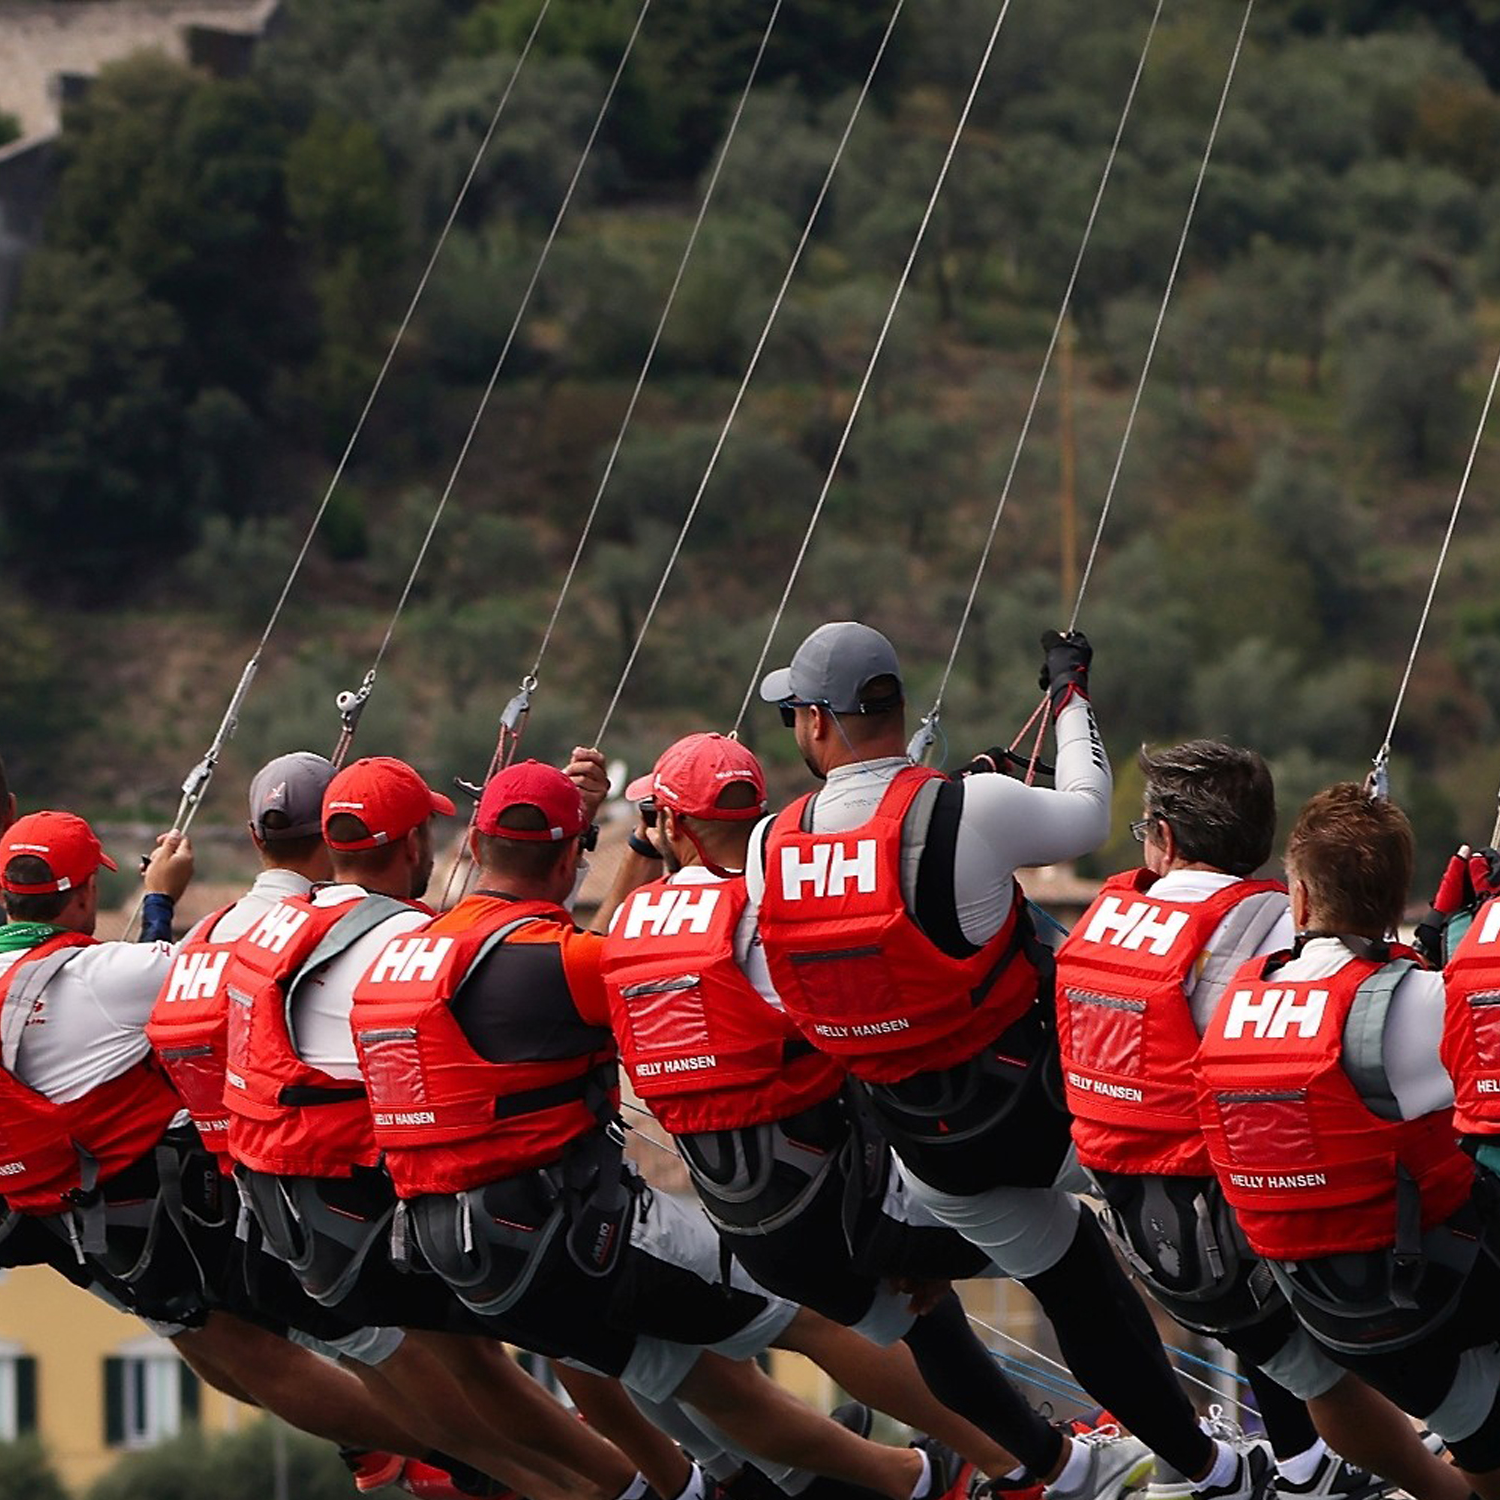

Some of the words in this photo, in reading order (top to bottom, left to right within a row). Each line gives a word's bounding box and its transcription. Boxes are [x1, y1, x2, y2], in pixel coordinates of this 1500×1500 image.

[780, 839, 877, 900] HH
[248, 902, 310, 954] HH
[624, 889, 721, 939] HH
[1083, 896, 1190, 956] HH
[165, 951, 231, 1002] HH
[370, 937, 455, 983] HH
[851, 1018, 910, 1037] HANSEN
[1223, 989, 1329, 1039] HH
[664, 1055, 716, 1073] HANSEN
[1093, 1081, 1143, 1103] HANSEN
[394, 1112, 435, 1126] HANSEN
[1229, 1173, 1264, 1189] HELLY
[1267, 1173, 1327, 1189] HANSEN
